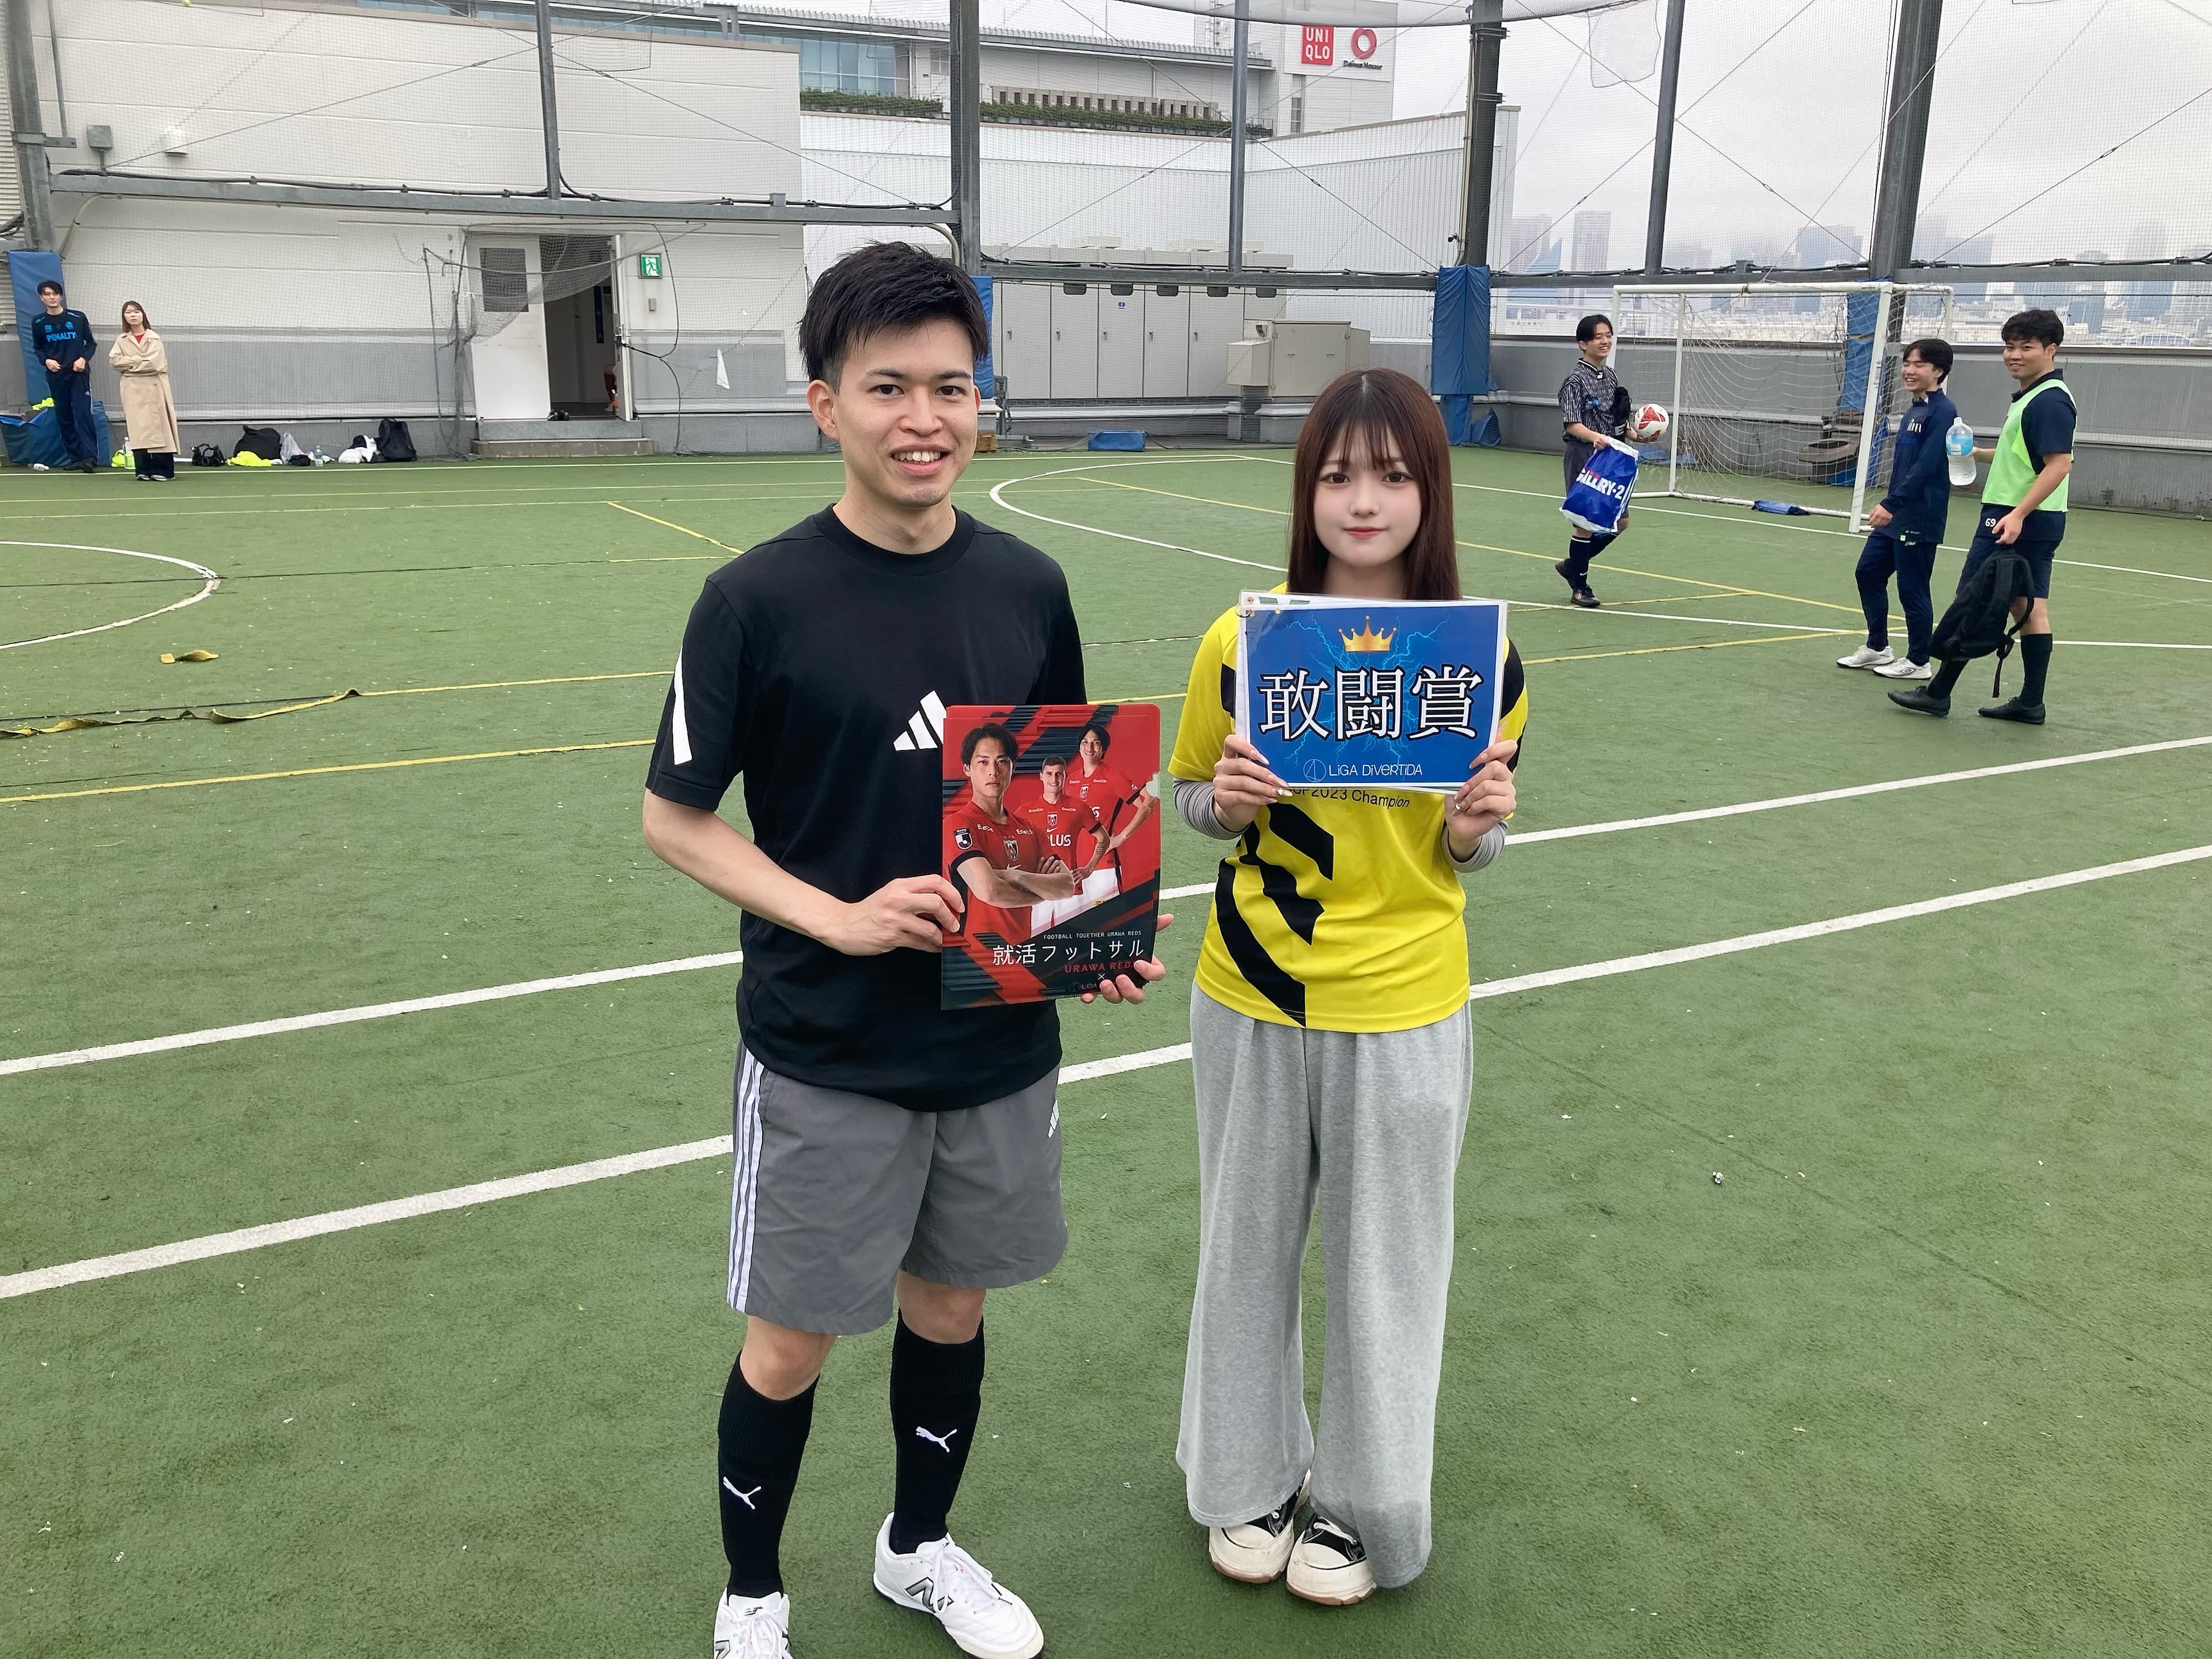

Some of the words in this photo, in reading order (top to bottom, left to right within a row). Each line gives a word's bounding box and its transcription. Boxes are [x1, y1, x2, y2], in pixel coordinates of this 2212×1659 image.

[1306, 27, 1329, 43] UNI
[1305, 44, 1330, 61] QLO
[46, 332, 76, 342] PENALTY
[1985, 518, 1996, 527] 69
[1257, 665, 1482, 741] 敢闘賞
[1311, 788, 1348, 801] 2023
[1351, 789, 1410, 810] Champion
[1048, 835, 1071, 847] LUS
[992, 939, 1145, 966] 就活フットサル
[1063, 963, 1106, 974] URAWA
